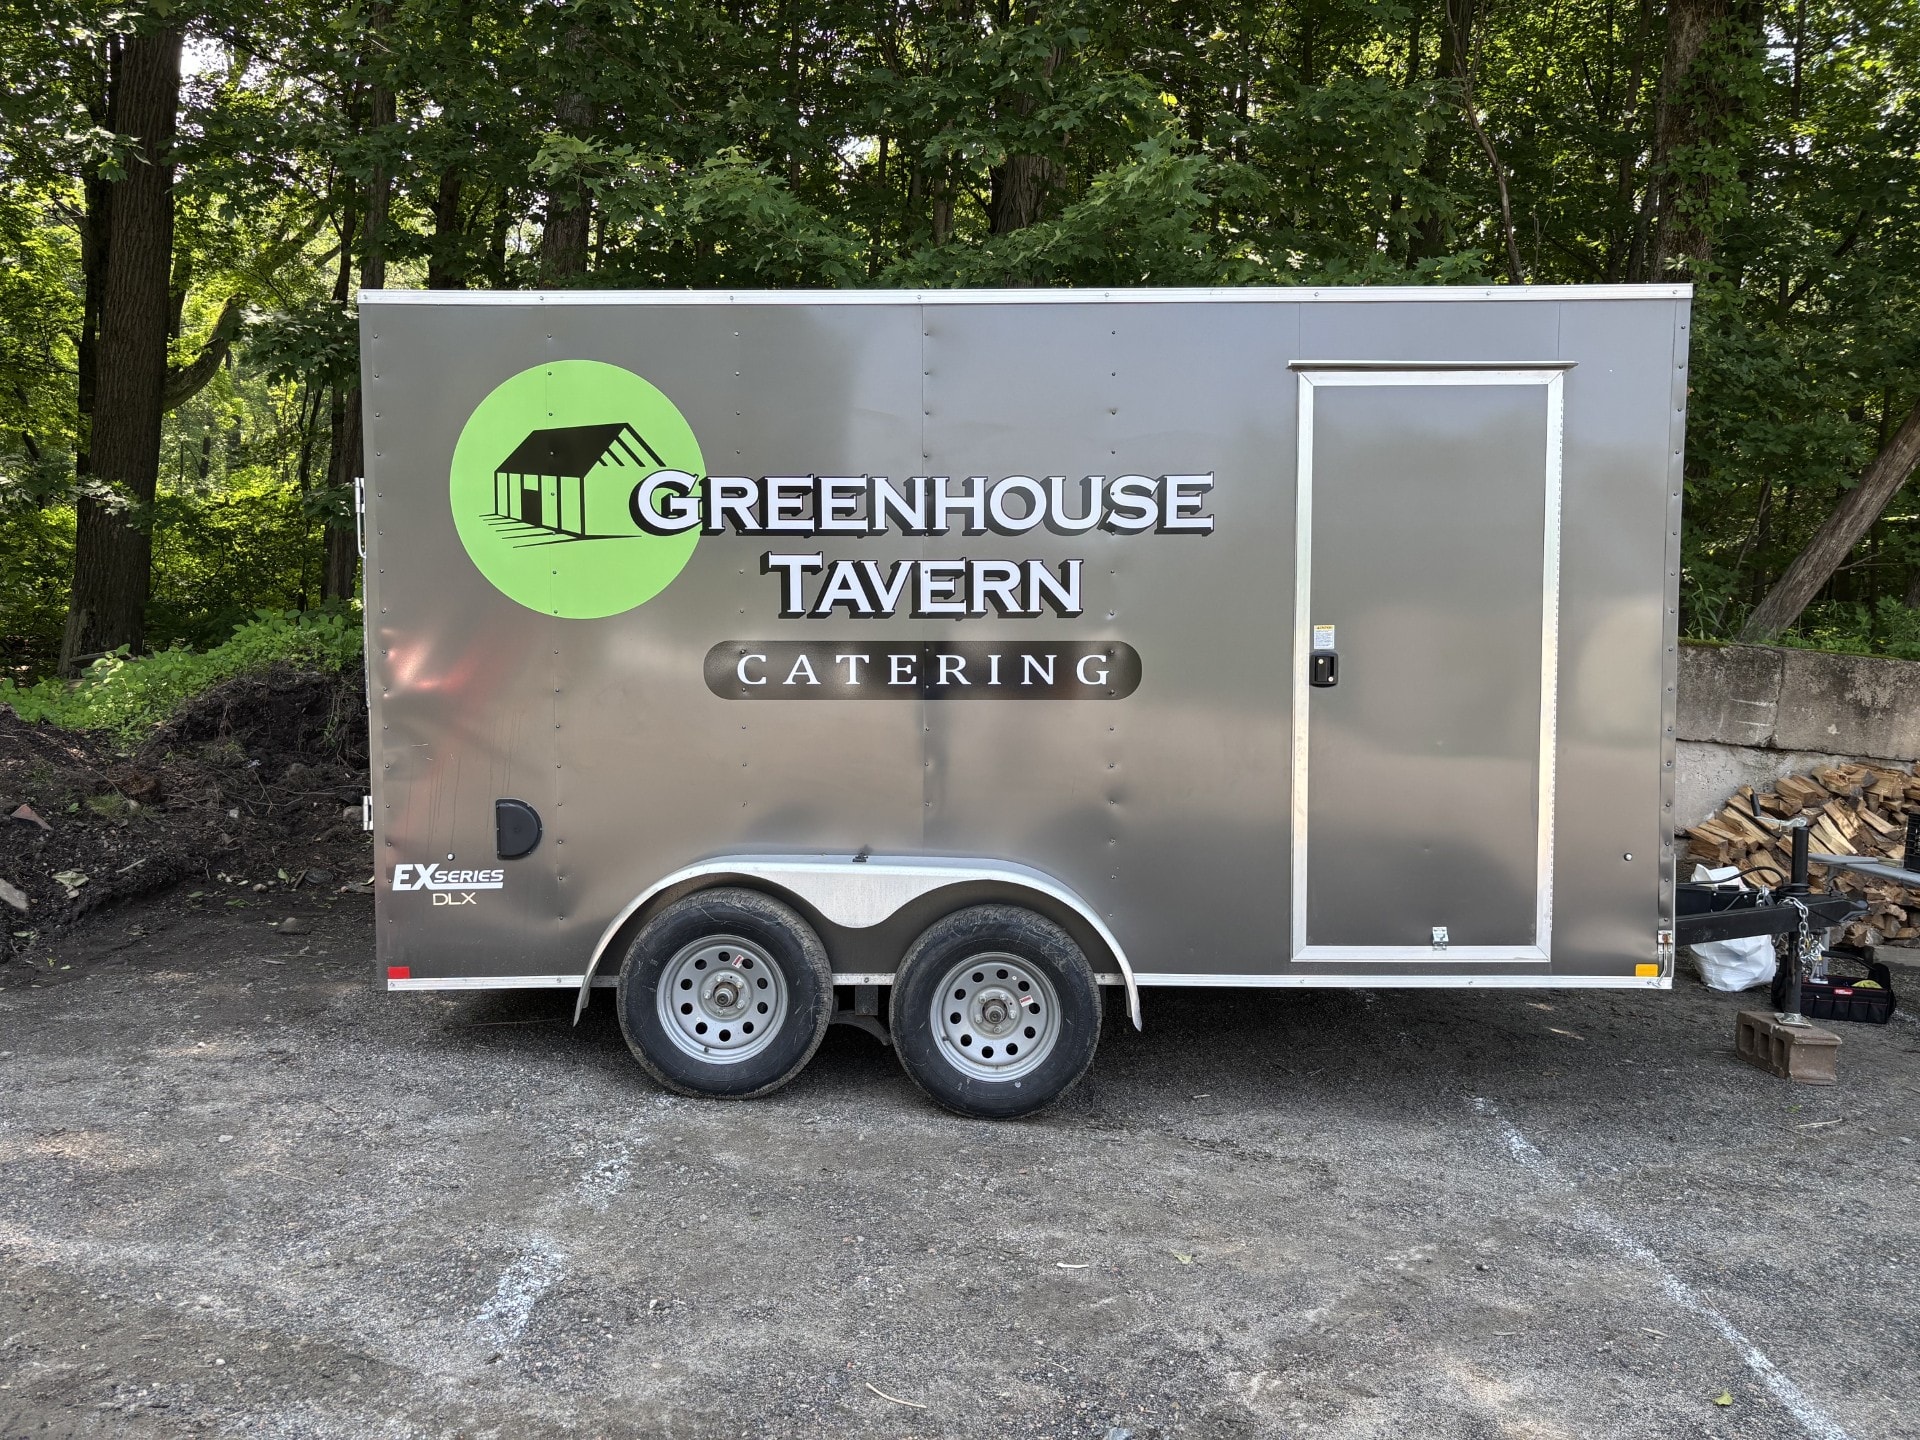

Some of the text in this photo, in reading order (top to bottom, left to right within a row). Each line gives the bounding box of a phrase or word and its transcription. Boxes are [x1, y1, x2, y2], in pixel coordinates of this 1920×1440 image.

[629, 469, 1214, 538] GREENHOUSE
[760, 550, 1084, 621] TAVERN
[737, 654, 1110, 685] CATERING
[432, 892, 477, 906] DLX
